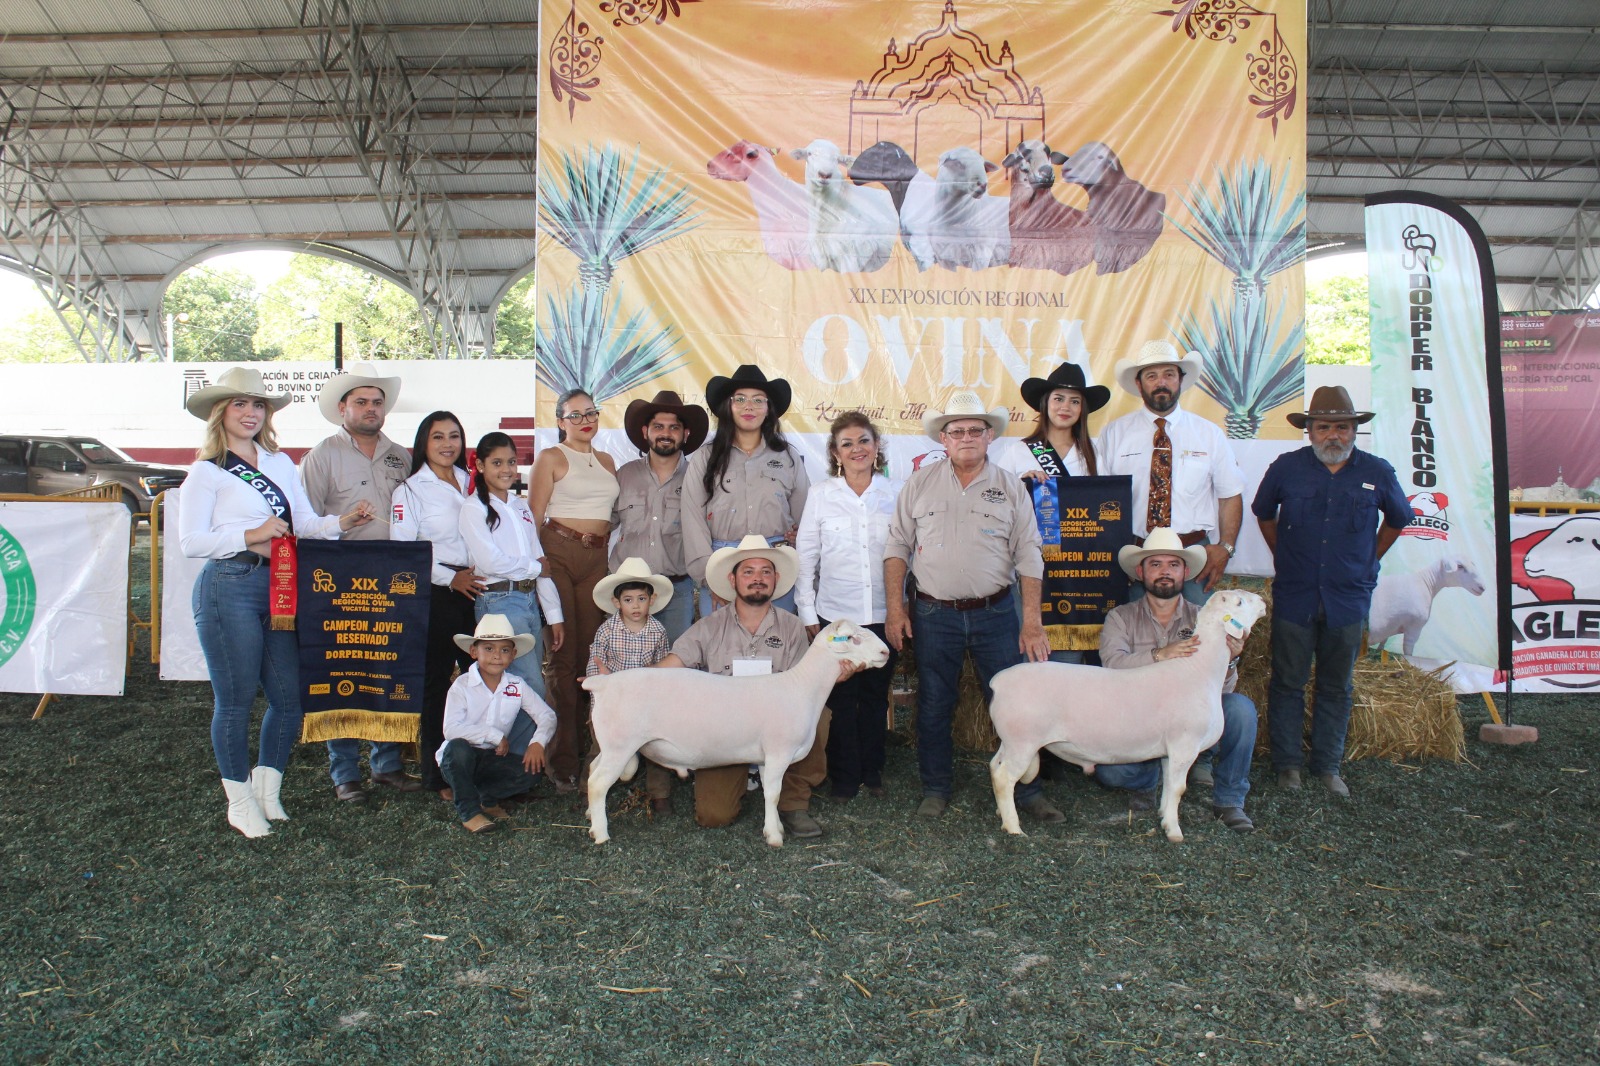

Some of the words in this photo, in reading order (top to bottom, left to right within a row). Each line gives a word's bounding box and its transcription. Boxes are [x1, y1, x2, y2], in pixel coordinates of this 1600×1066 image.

[848, 288, 877, 304] XIX
[881, 287, 981, 306] EXPOSICIÓN
[985, 291, 1070, 308] REGIONAL
[1409, 274, 1433, 371] DORPER
[801, 313, 1096, 388] OVINA
[1520, 363, 1600, 371] INTERNACIONAL
[262, 370, 289, 380] ACIÓN
[293, 372, 305, 380] DE
[1503, 375, 1540, 384] ADERÍA
[1543, 375, 1592, 383] TROPICAL
[277, 383, 312, 392] BOVINO
[293, 394, 306, 403] DE
[1411, 387, 1437, 488] BLANCO
[228, 463, 286, 518] FOGYSA
[1066, 508, 1089, 519] XIX
[1060, 519, 1097, 527] EXPOSICIÓN
[1408, 517, 1450, 532] GLECO
[0, 533, 22, 571] MICA
[1087, 552, 1112, 562] JOVEN
[1048, 569, 1080, 578] DORPER
[1081, 569, 1110, 578] BLANCO
[313, 583, 336, 592] UNO
[351, 578, 379, 591] XIX
[341, 592, 388, 601] EXPOSICIÓN
[323, 620, 368, 631] CAMPEON
[372, 621, 403, 633] JOVEN
[1512, 610, 1600, 644] GLE
[336, 633, 389, 646] RESERVADO
[325, 650, 363, 660] DORPER
[364, 651, 398, 661] BLANCO
[1512, 652, 1536, 664] IACIÓN
[1536, 650, 1569, 661] GANADERA
[1570, 650, 1589, 659] LOCAL
[1545, 664, 1552, 672] DE
[1554, 663, 1576, 672] OVINOS
[1577, 663, 1585, 671] DE
